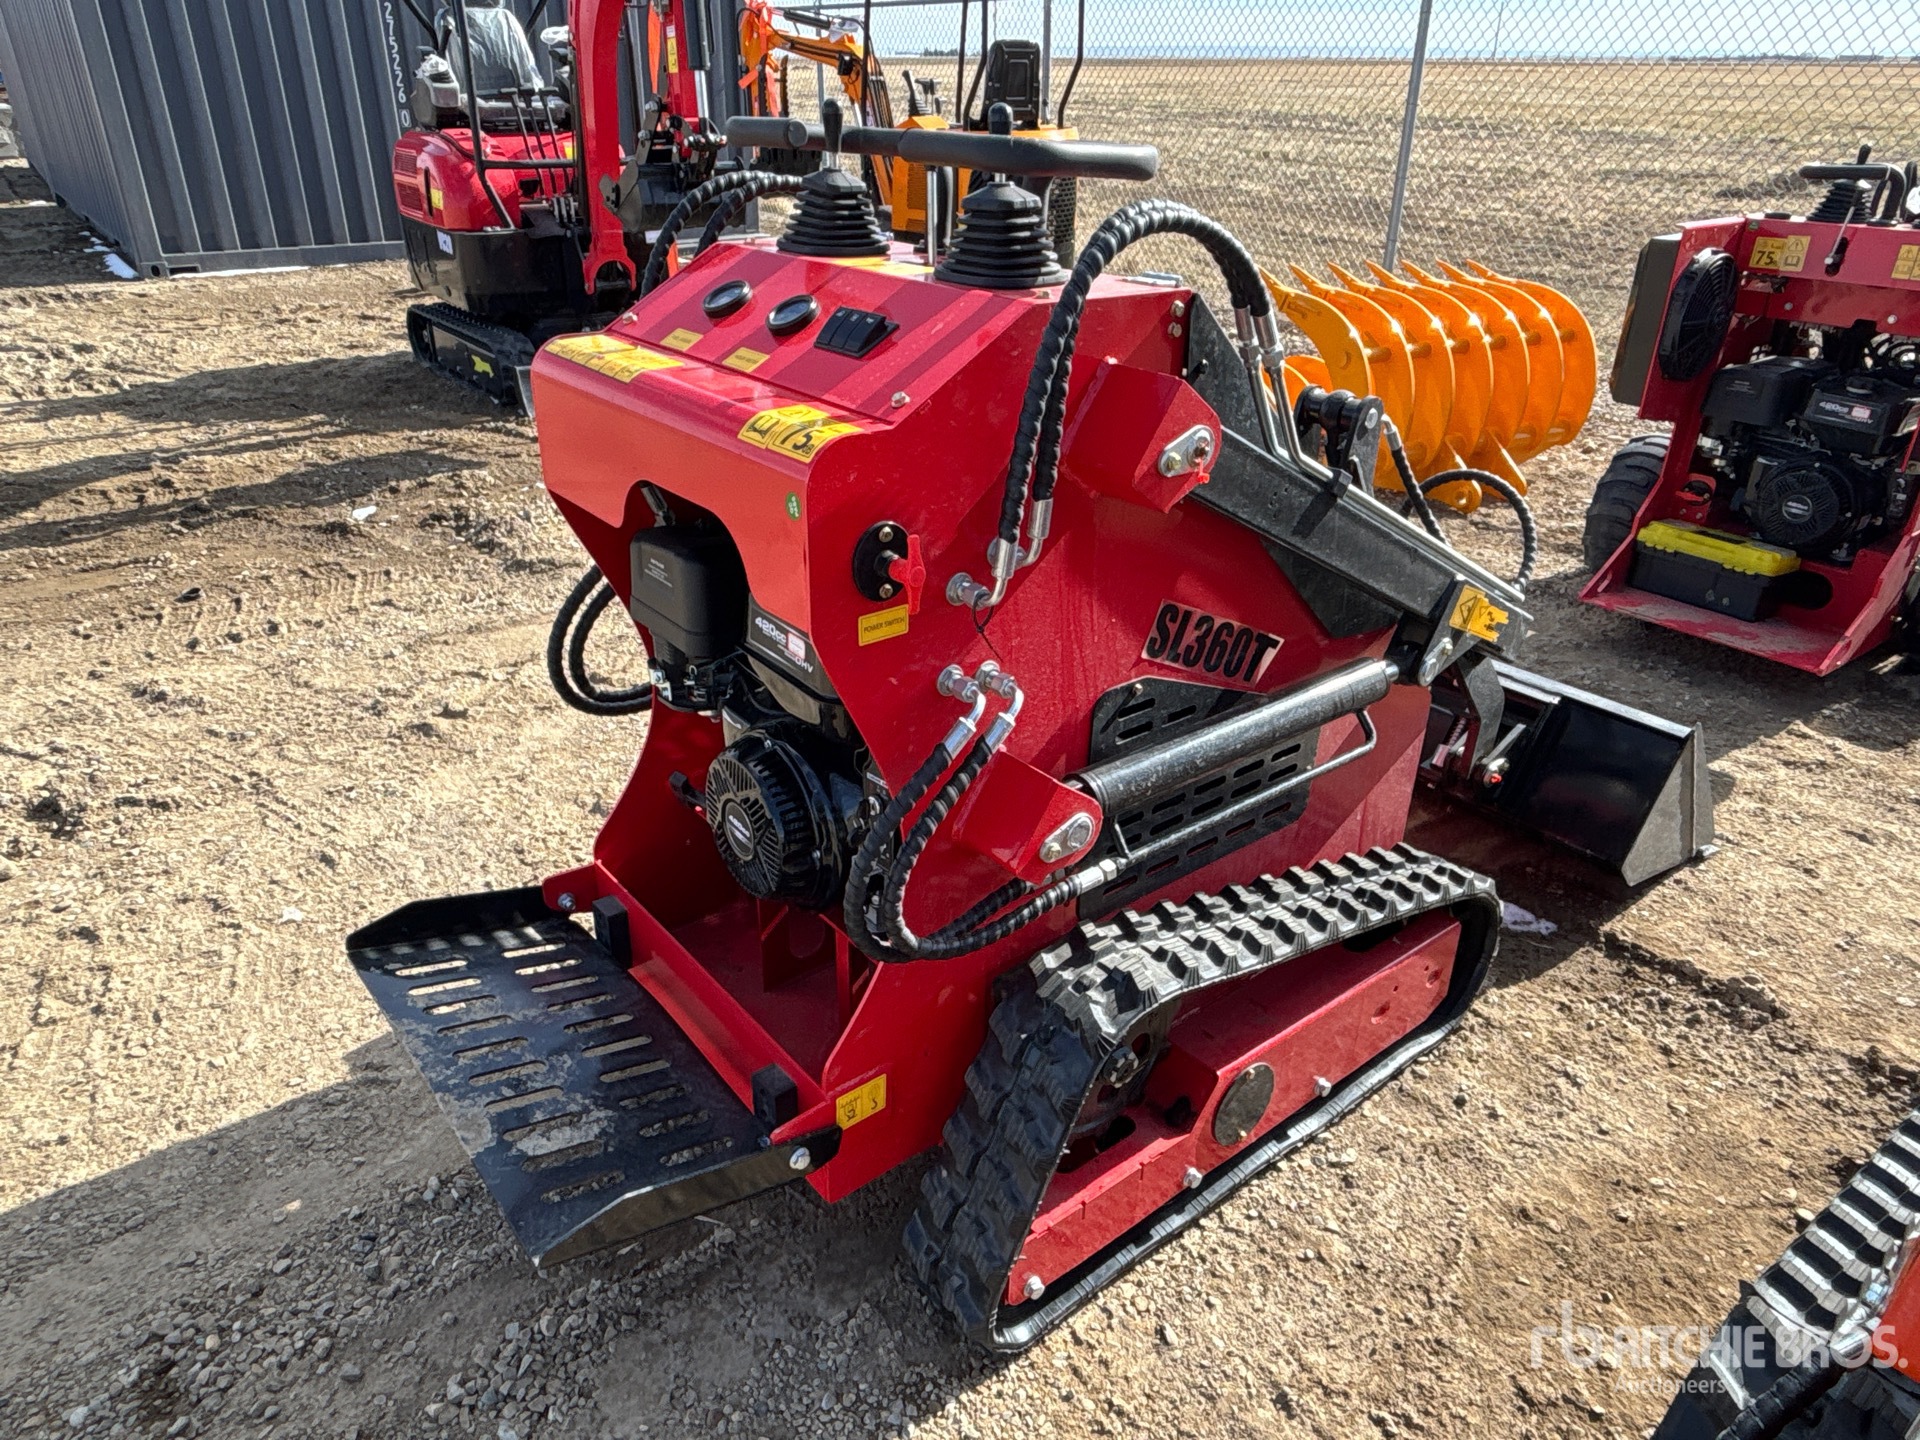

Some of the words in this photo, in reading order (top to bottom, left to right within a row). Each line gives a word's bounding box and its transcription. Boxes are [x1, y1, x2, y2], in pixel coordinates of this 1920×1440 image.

[383, 2, 407, 103] 275226
[755, 617, 787, 643] 420cc
[863, 622, 883, 633] POWER
[884, 616, 904, 627] SWITCH
[1146, 603, 1281, 682] SL360T
[795, 656, 814, 673] OHV
